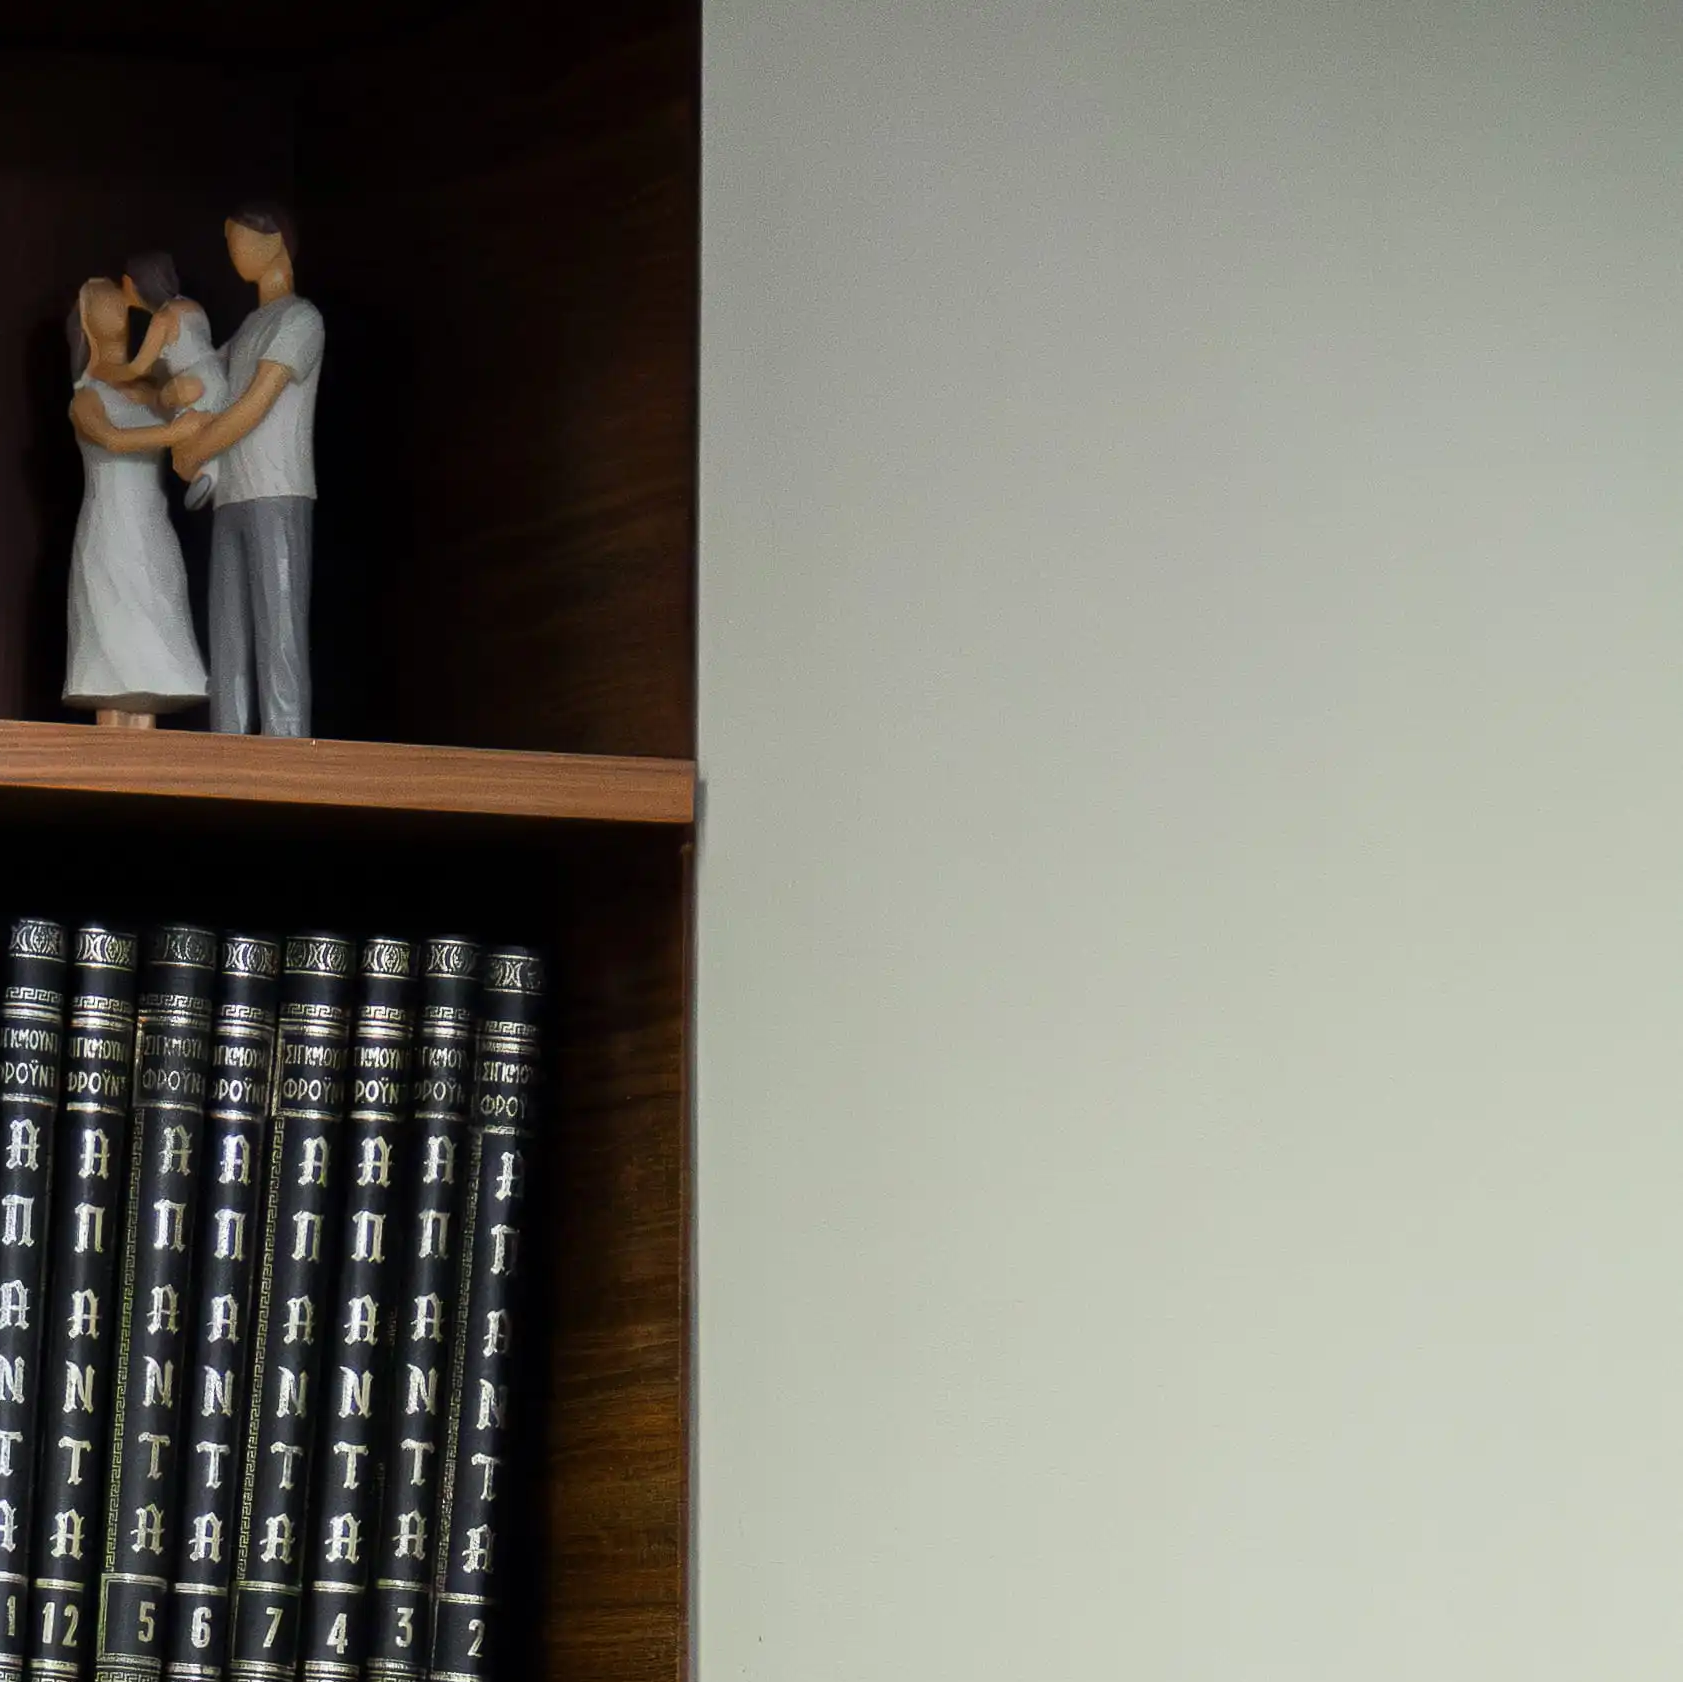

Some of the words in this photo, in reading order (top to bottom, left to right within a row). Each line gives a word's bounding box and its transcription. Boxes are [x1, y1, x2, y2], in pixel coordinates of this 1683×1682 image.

[42, 1602, 79, 1647] 12
[138, 1602, 156, 1642] 5
[191, 1606, 212, 1648] 6
[262, 1607, 284, 1648] 7
[326, 1612, 349, 1654] 4
[395, 1607, 414, 1647] 3
[468, 1619, 485, 1657] 2
